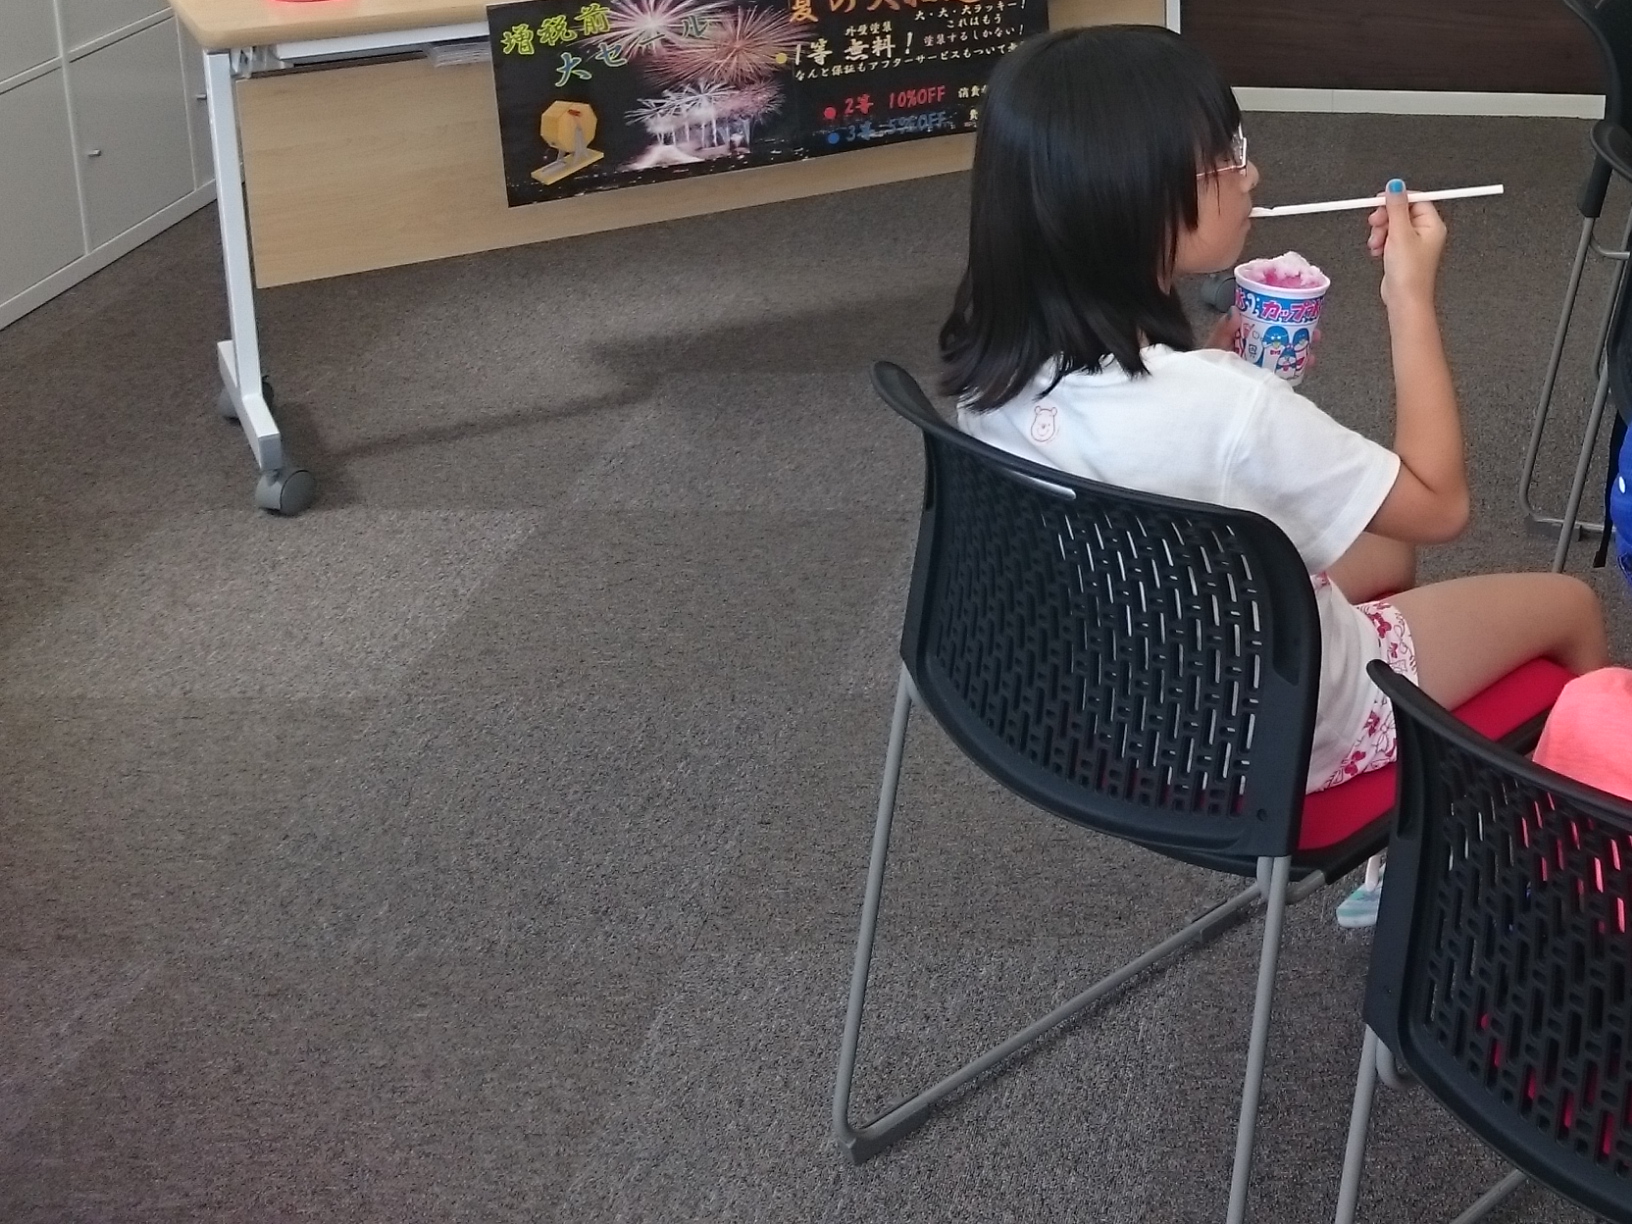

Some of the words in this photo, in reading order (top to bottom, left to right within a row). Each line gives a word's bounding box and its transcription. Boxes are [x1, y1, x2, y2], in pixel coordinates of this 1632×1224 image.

[502, 2, 611, 56] 増税前
[844, 19, 893, 37] 外壁塗装
[946, 12, 1003, 29] これはもう
[555, 14, 709, 88] 大セール
[843, 93, 874, 115] 2等
[888, 85, 947, 109] 10%OFF
